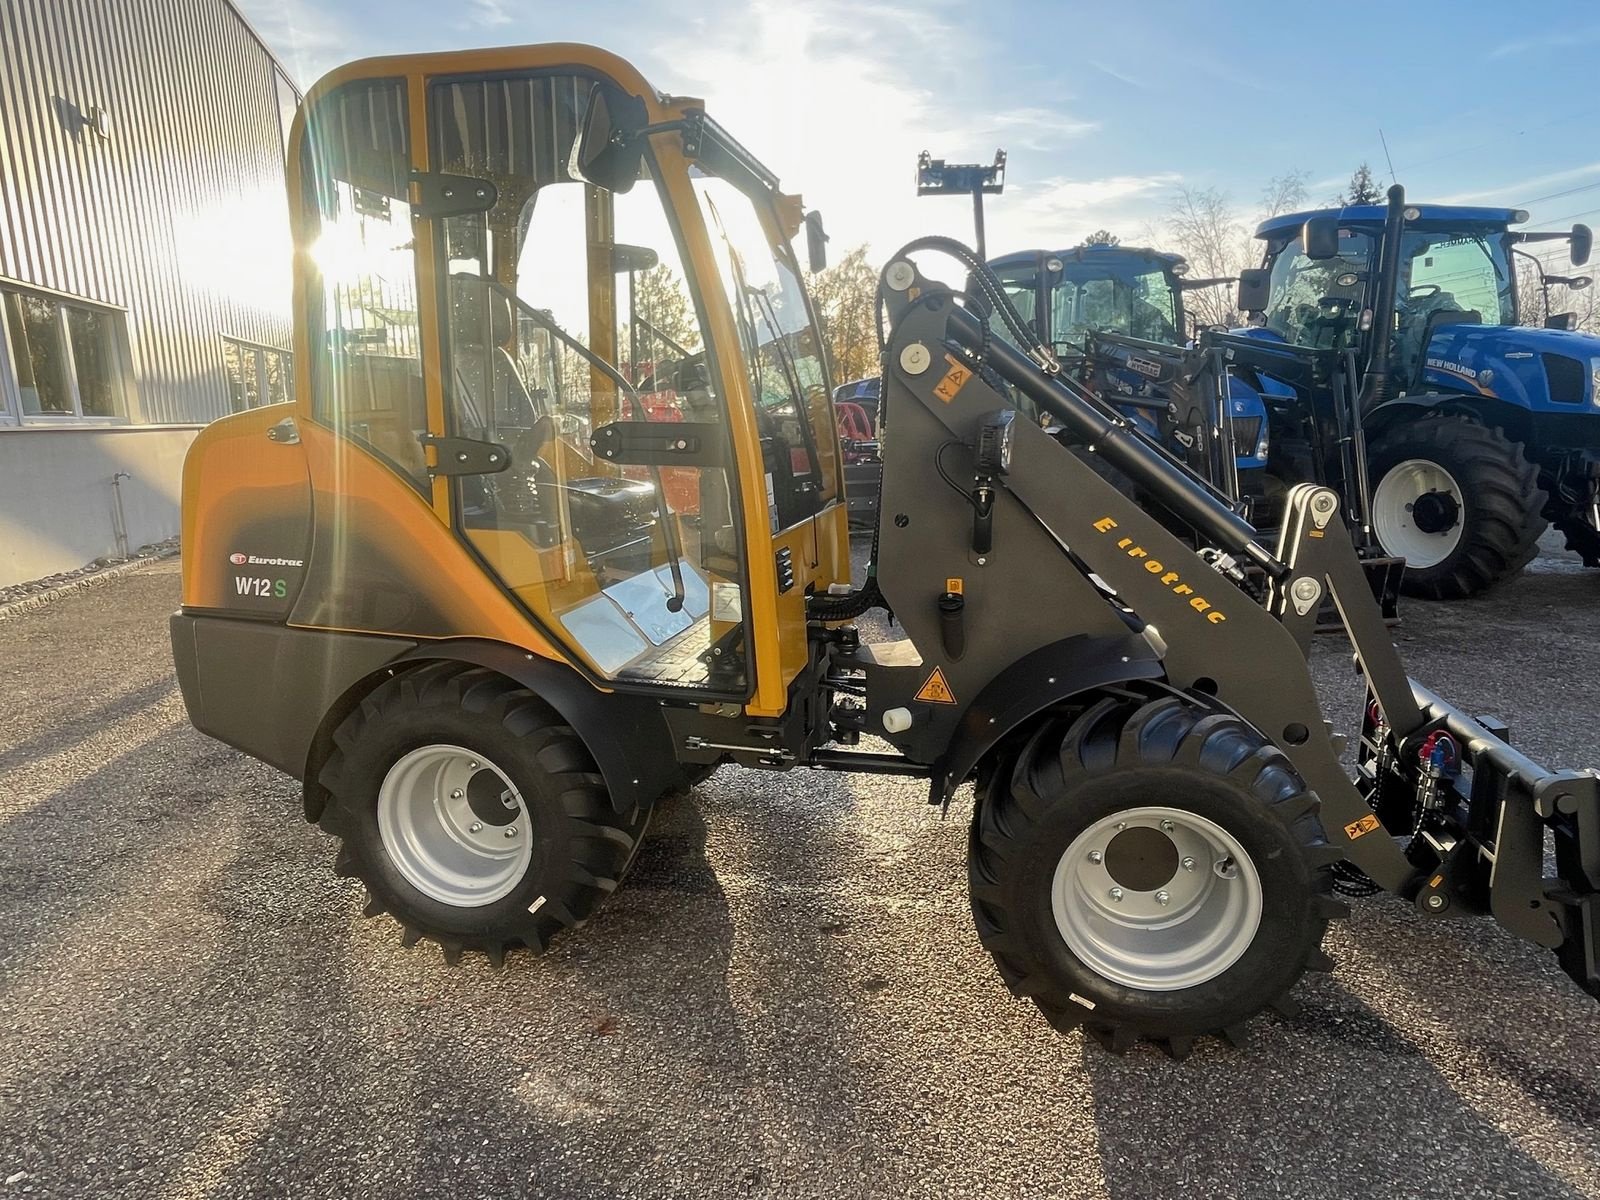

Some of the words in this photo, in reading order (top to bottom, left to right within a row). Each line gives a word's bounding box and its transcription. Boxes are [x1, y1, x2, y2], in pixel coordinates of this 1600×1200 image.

[1427, 358, 1443, 367] NEW
[1443, 361, 1476, 378] HOLLAND
[248, 556, 303, 567] Eurotrac
[235, 576, 271, 597] W12
[274, 579, 287, 597] S
